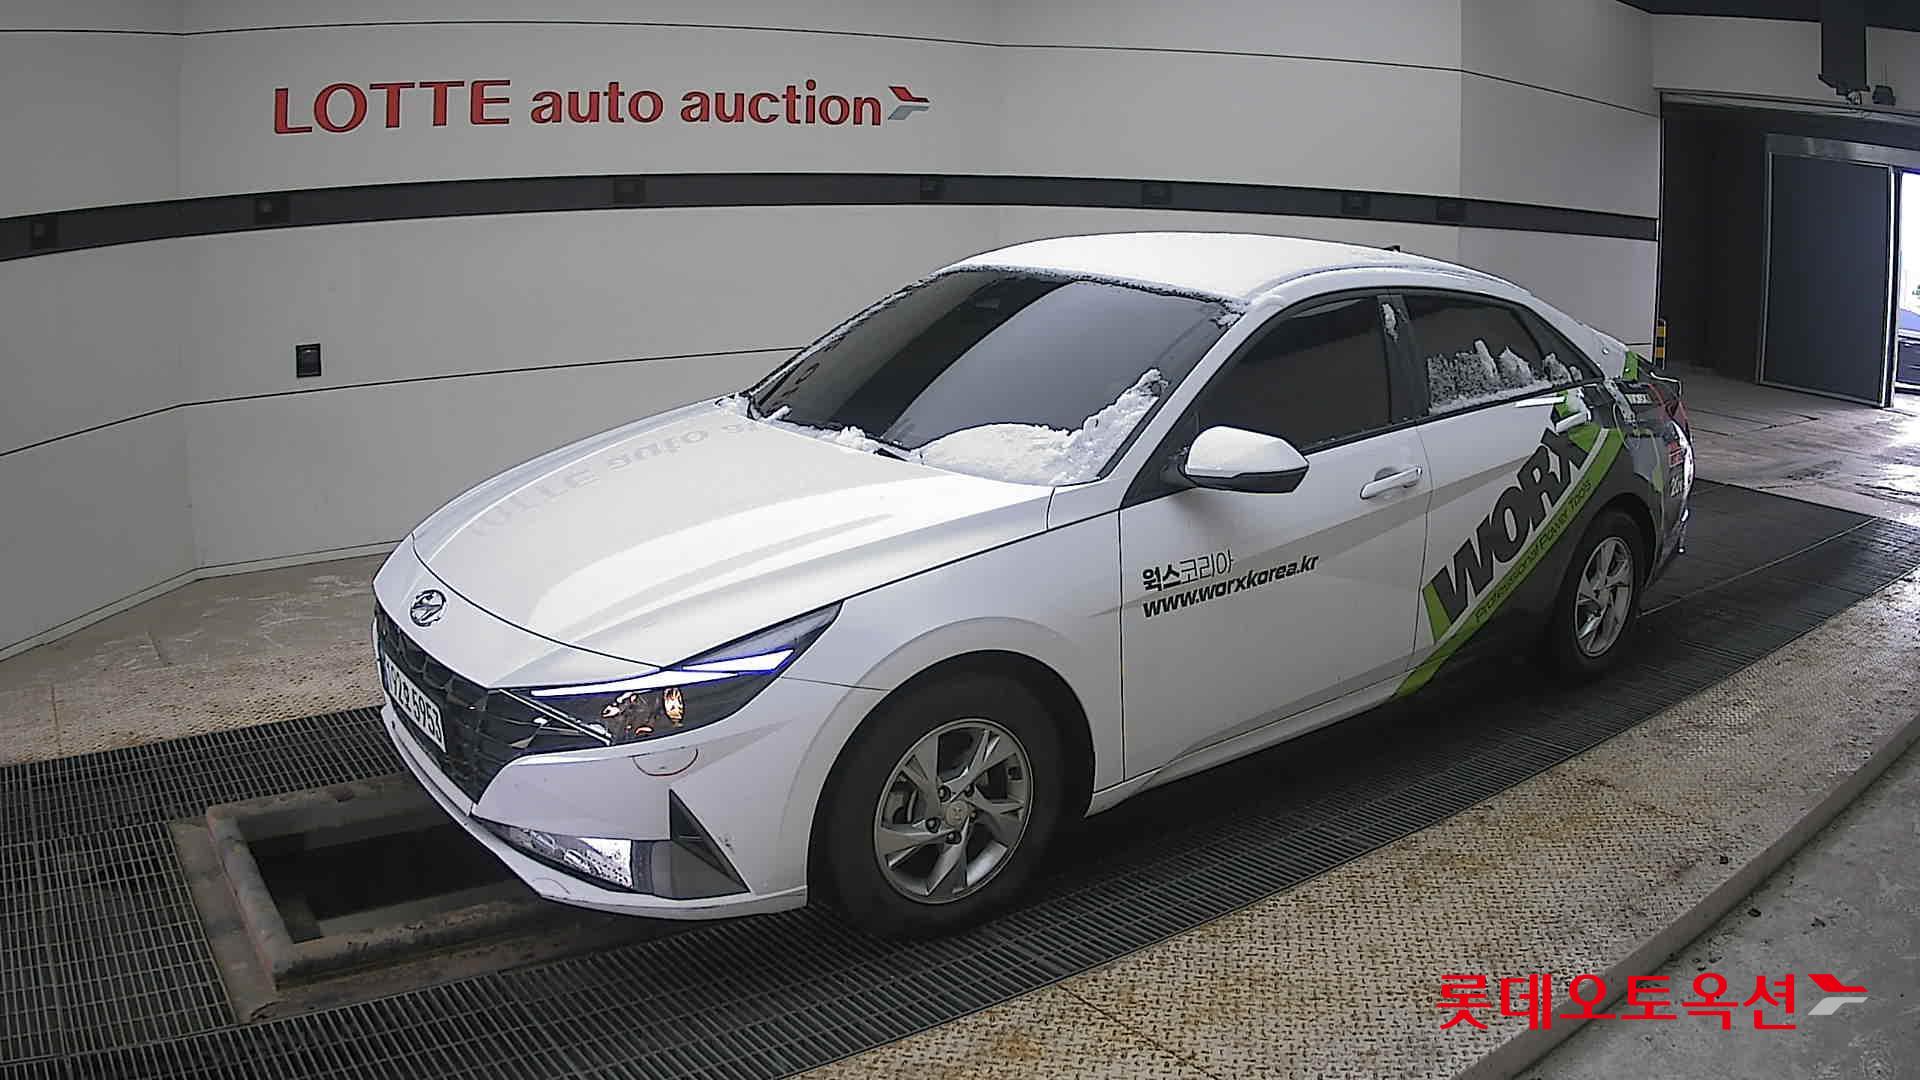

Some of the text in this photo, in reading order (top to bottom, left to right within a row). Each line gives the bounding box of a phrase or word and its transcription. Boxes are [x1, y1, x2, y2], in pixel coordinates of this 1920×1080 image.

[273, 79, 882, 135] LOTTE auto auction
[1429, 406, 1591, 629] WORX
[1142, 549, 1234, 592] 웍스코리아
[1142, 555, 1320, 618] www.worxkorea.kr
